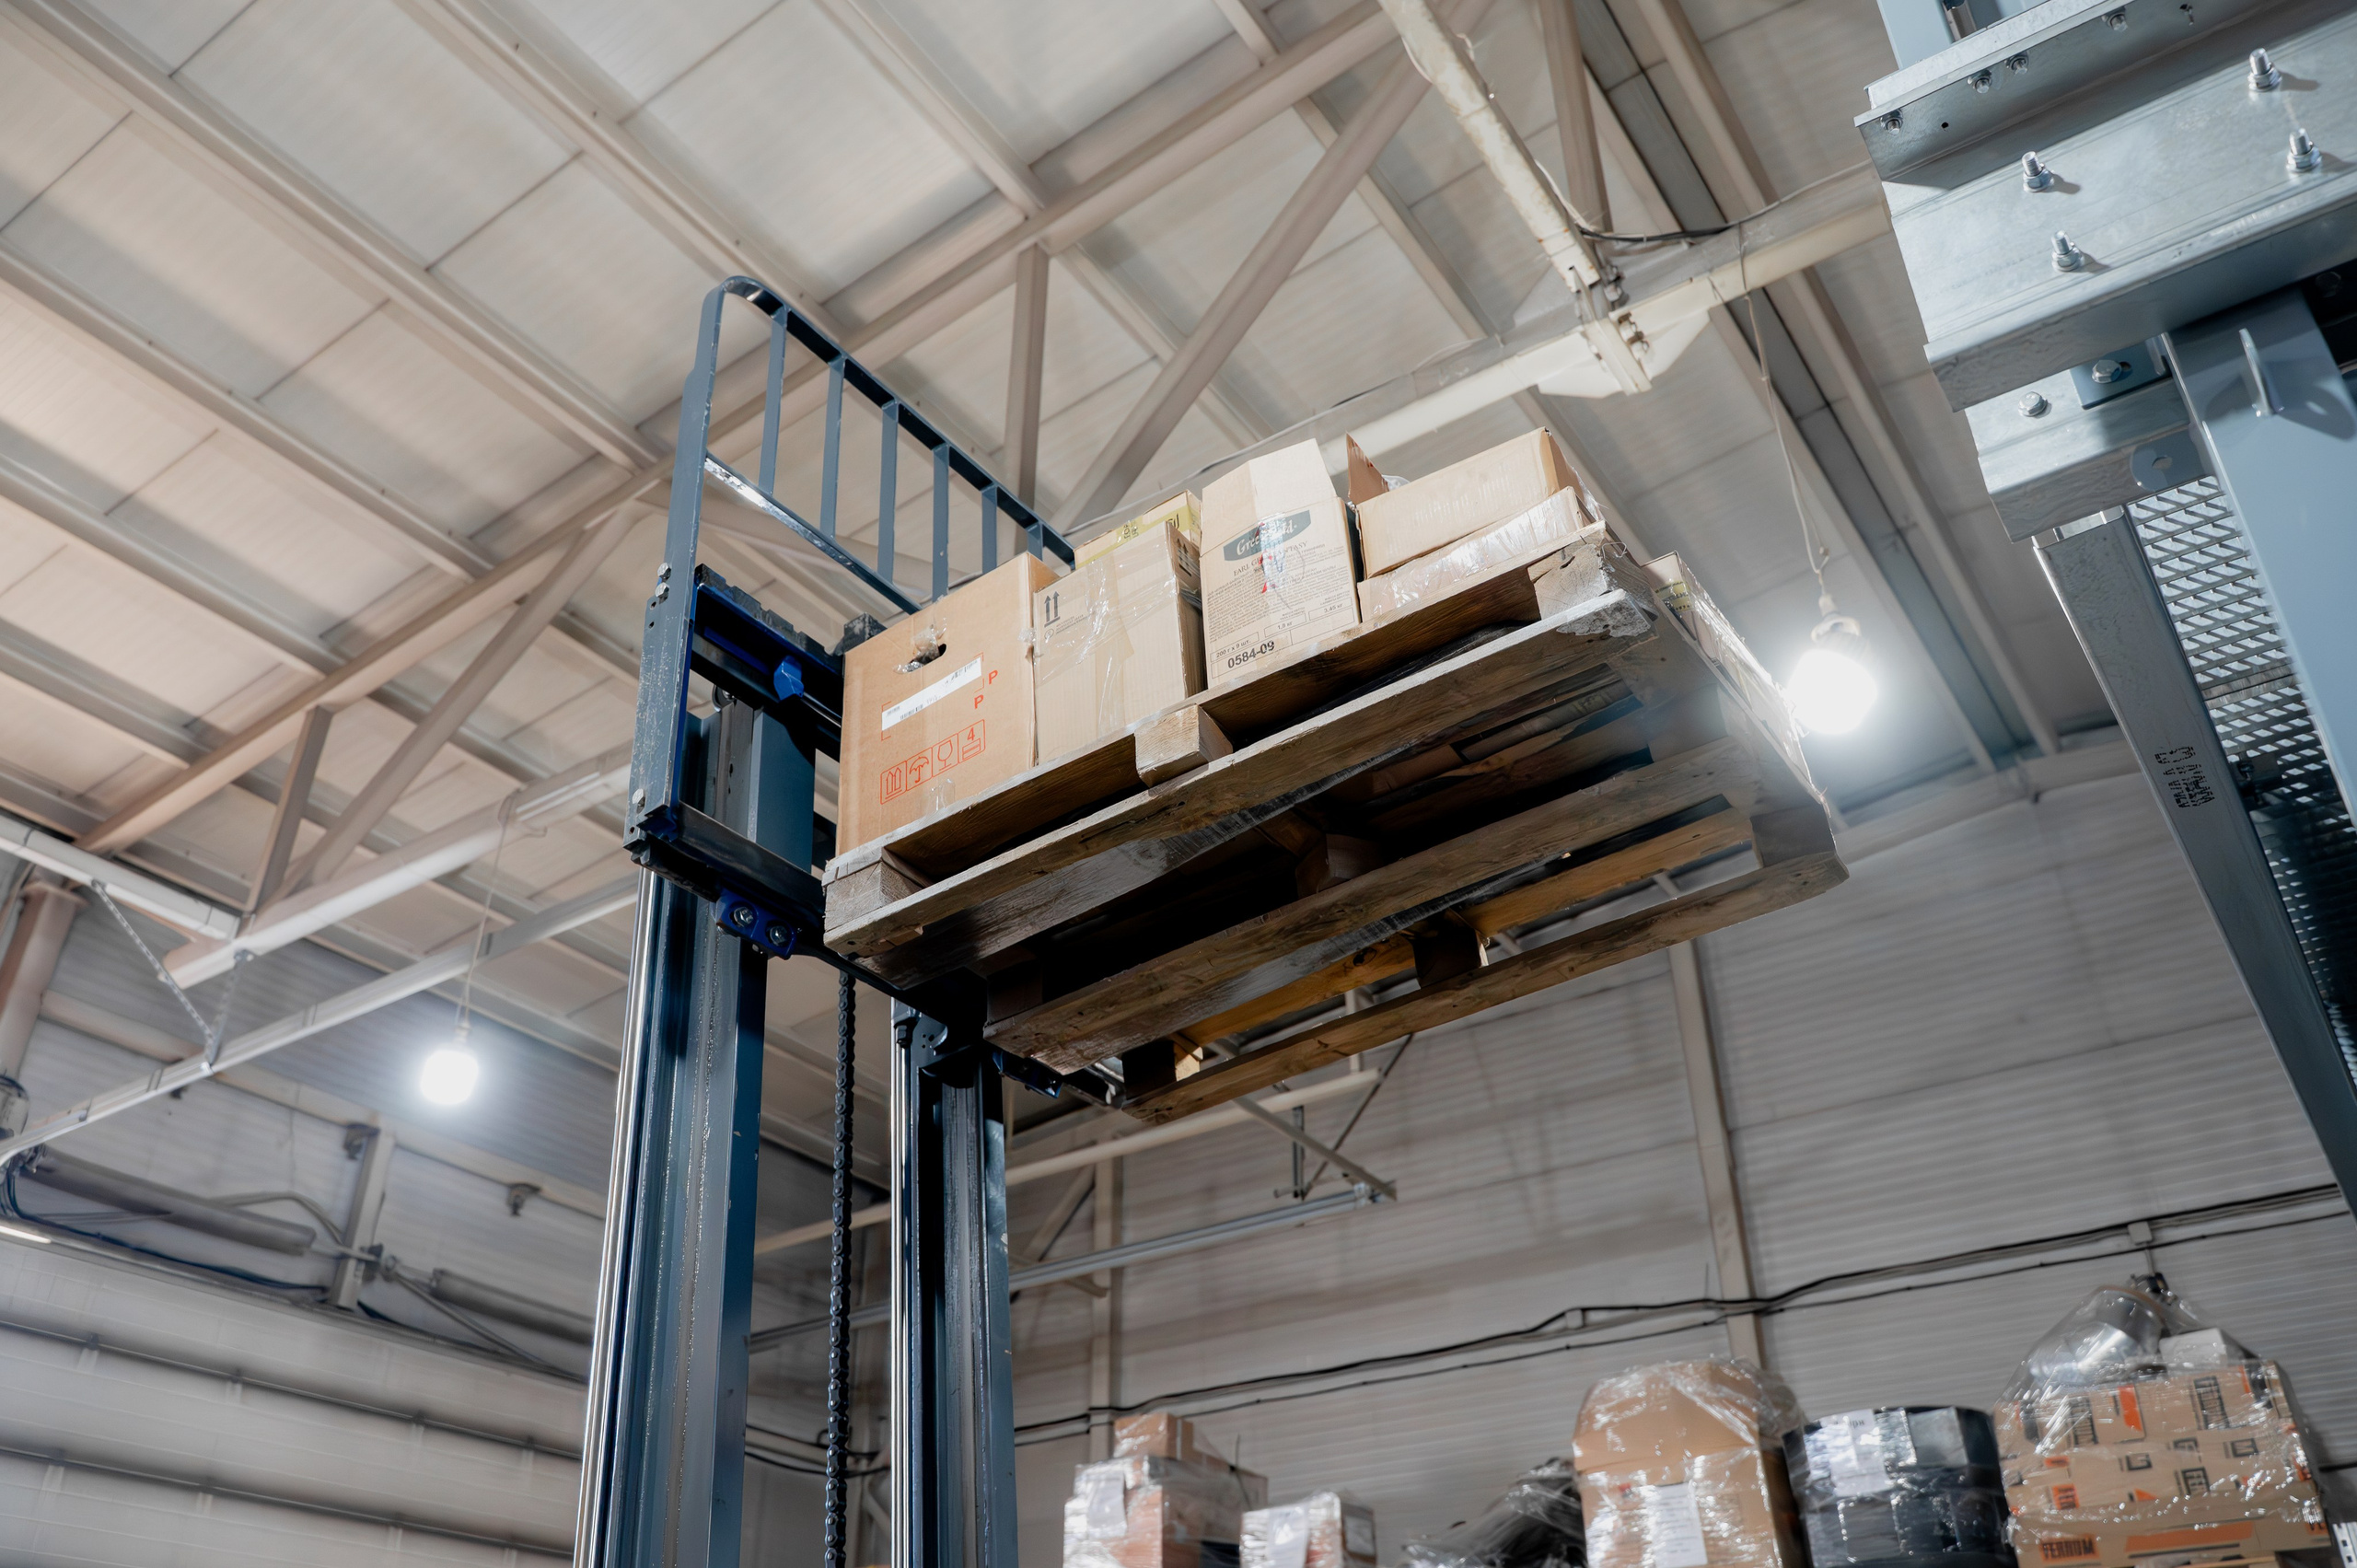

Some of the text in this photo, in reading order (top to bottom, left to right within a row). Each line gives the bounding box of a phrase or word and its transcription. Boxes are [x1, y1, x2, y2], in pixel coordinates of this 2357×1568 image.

[1234, 563, 1250, 576] EARL
[1216, 649, 1226, 658] 200
[1227, 640, 1275, 668] 0584-09
[988, 669, 998, 684] P
[974, 694, 984, 709] P
[967, 726, 976, 740] 4
